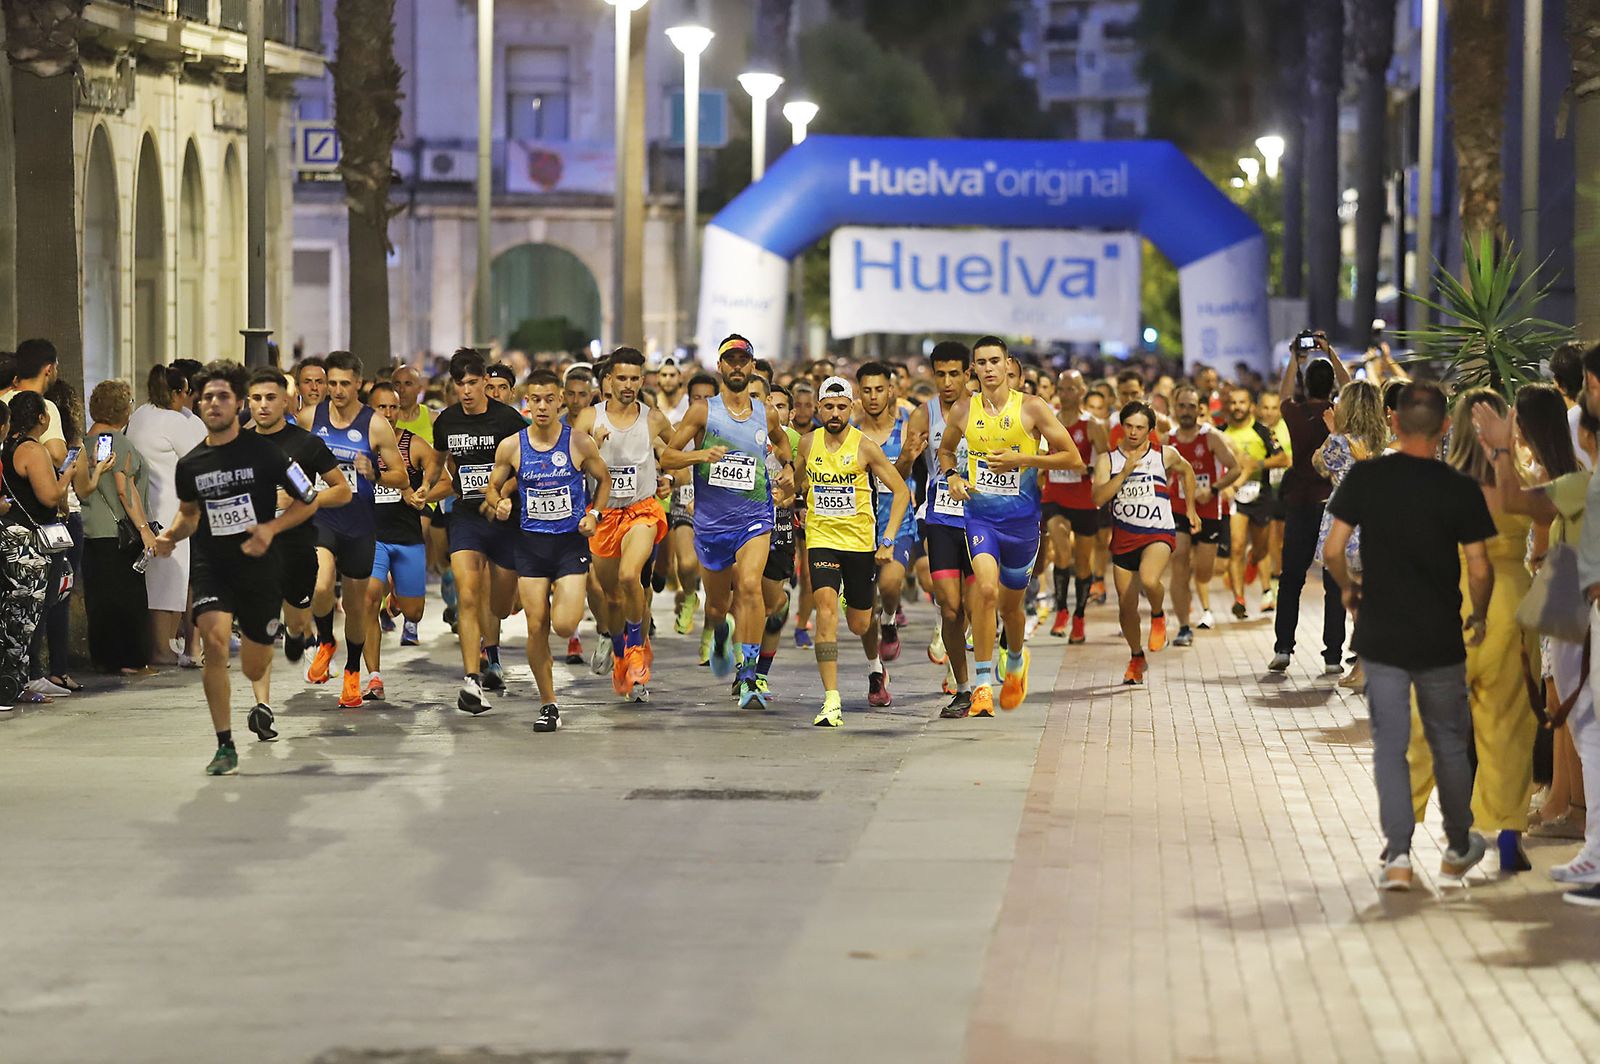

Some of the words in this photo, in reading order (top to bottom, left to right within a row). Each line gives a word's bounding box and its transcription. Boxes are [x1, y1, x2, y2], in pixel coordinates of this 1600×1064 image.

[848, 159, 984, 196] Huelva
[995, 159, 1128, 206] original
[853, 239, 1099, 298] Huelva
[464, 436, 478, 446] FOR
[479, 435, 494, 446] FUN
[216, 471, 233, 485] FOR
[234, 468, 254, 480] FUN
[722, 466, 743, 479] 646
[471, 475, 489, 486] 604
[986, 473, 1007, 486] 249
[1126, 486, 1144, 497] 303
[541, 500, 556, 512] 13
[823, 496, 844, 508] 655
[218, 510, 241, 525] 198
[1113, 501, 1162, 521] CODA
